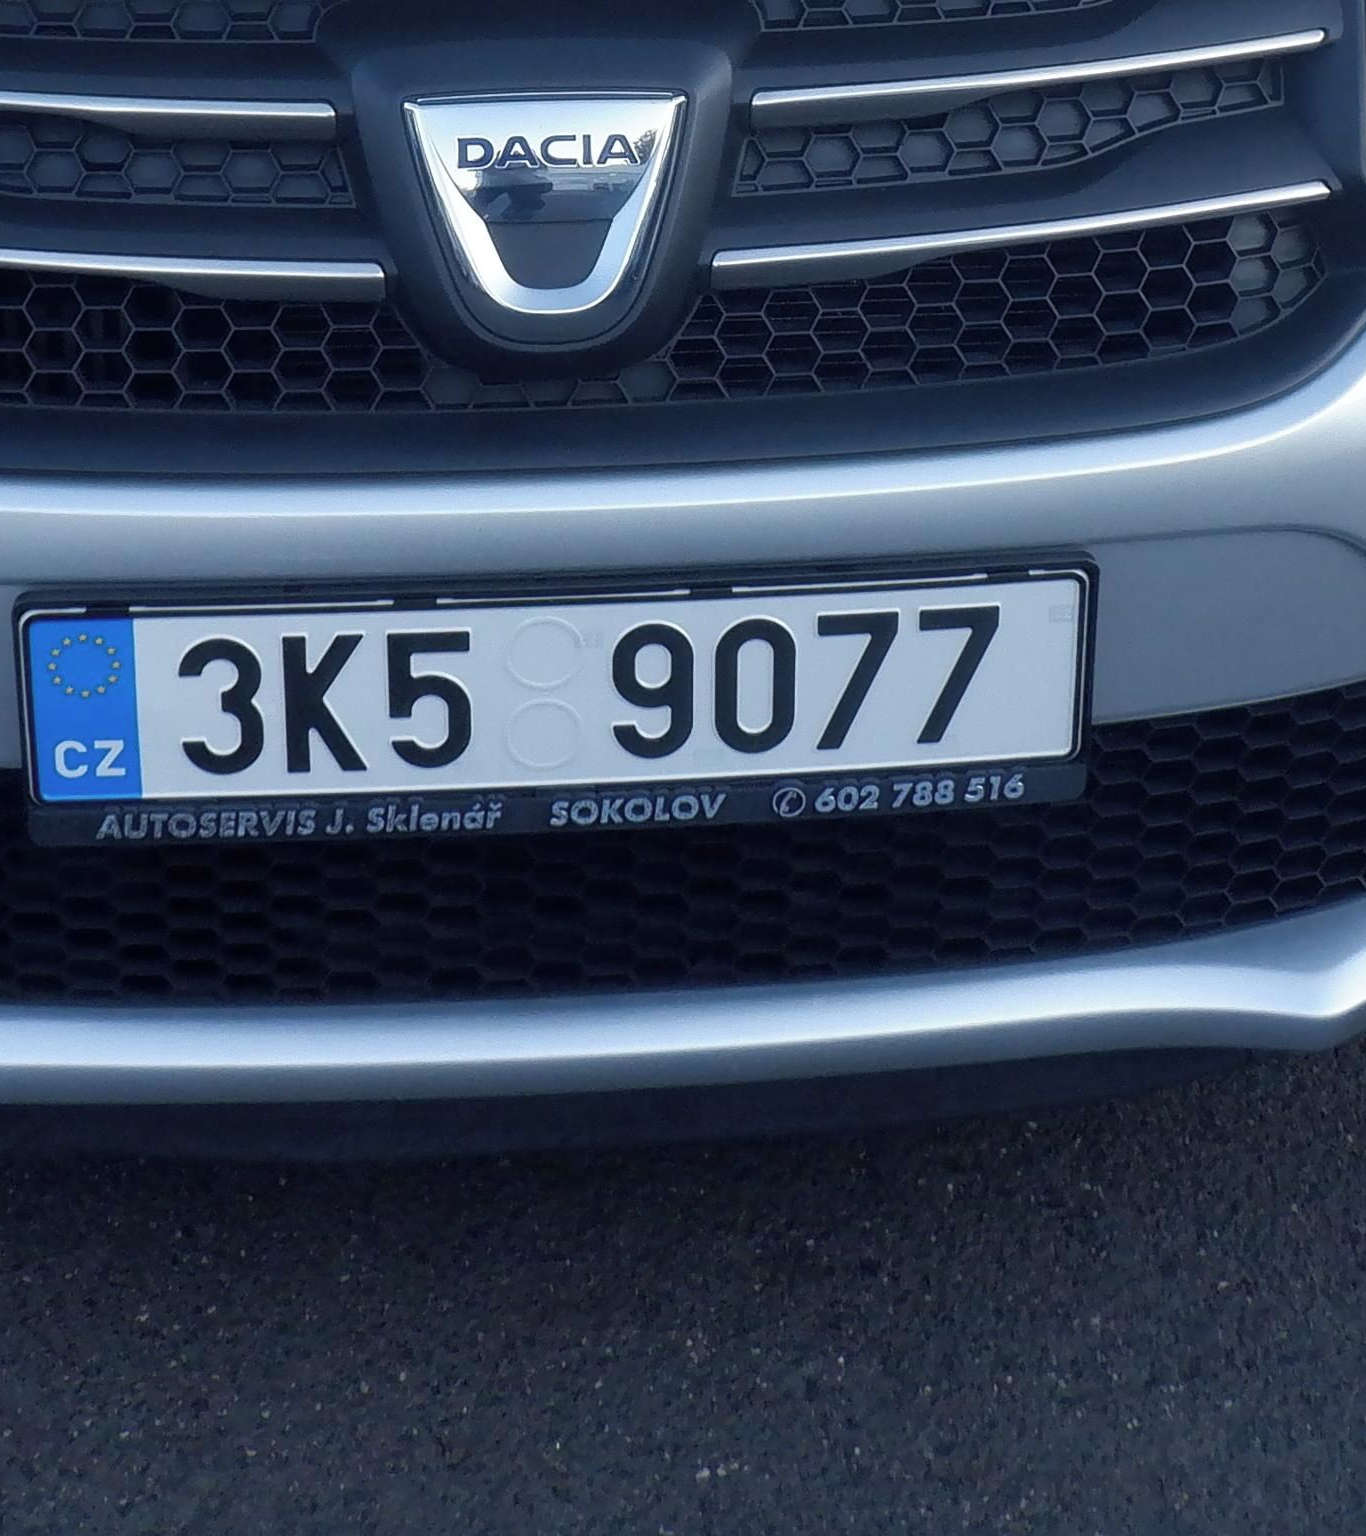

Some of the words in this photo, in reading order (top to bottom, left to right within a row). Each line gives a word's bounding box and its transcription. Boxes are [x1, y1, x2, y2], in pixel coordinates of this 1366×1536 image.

[456, 133, 640, 170] DACIA
[178, 630, 473, 776] 3K5
[611, 604, 1001, 759] 9077
[53, 739, 128, 779] CZ
[95, 807, 316, 841] AUTOSERVIS
[325, 809, 355, 835] J.
[366, 801, 503, 836] Sklenář
[549, 791, 728, 828] SOKOLOV
[814, 784, 881, 813] 602
[892, 780, 955, 809] 788
[964, 773, 1026, 804] 516
